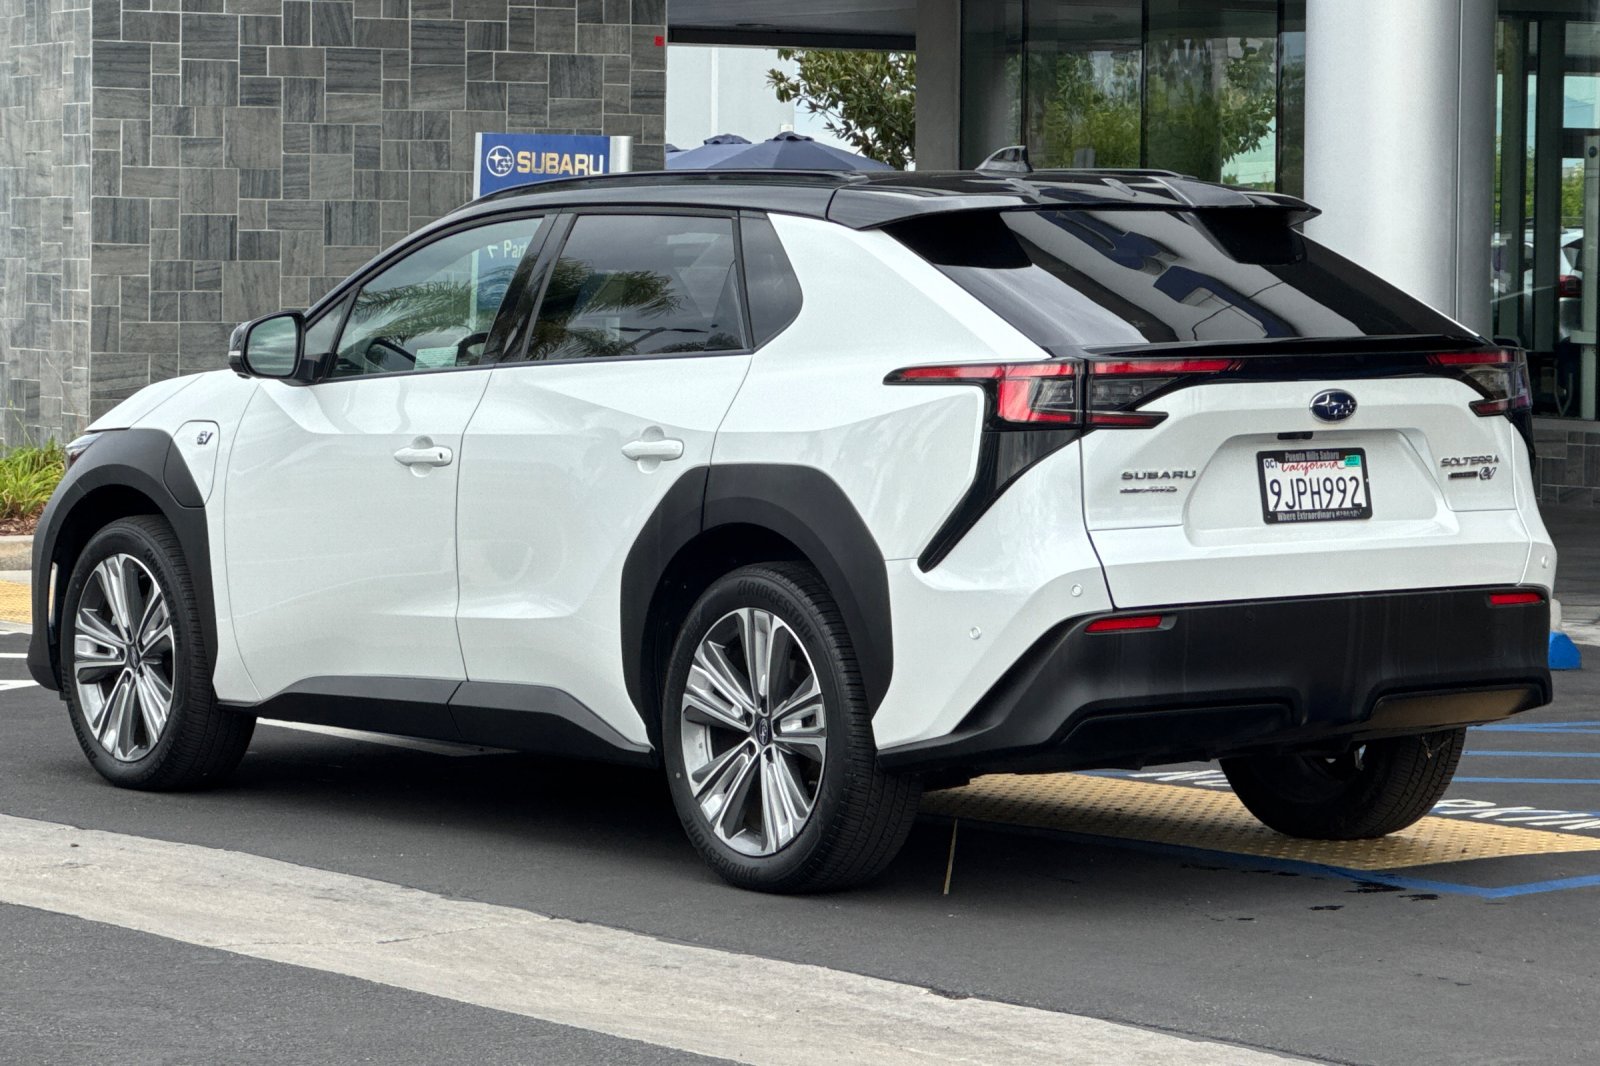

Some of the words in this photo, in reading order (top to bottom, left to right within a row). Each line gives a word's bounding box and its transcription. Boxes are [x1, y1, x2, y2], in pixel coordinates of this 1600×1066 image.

[516, 150, 604, 176] SUBARU
[1320, 450, 1340, 460] Subaru
[1440, 455, 1499, 467] SOLTERRA
[1281, 460, 1345, 476] California
[1121, 470, 1197, 481] SUBARU
[1269, 476, 1363, 511] 9JPH992
